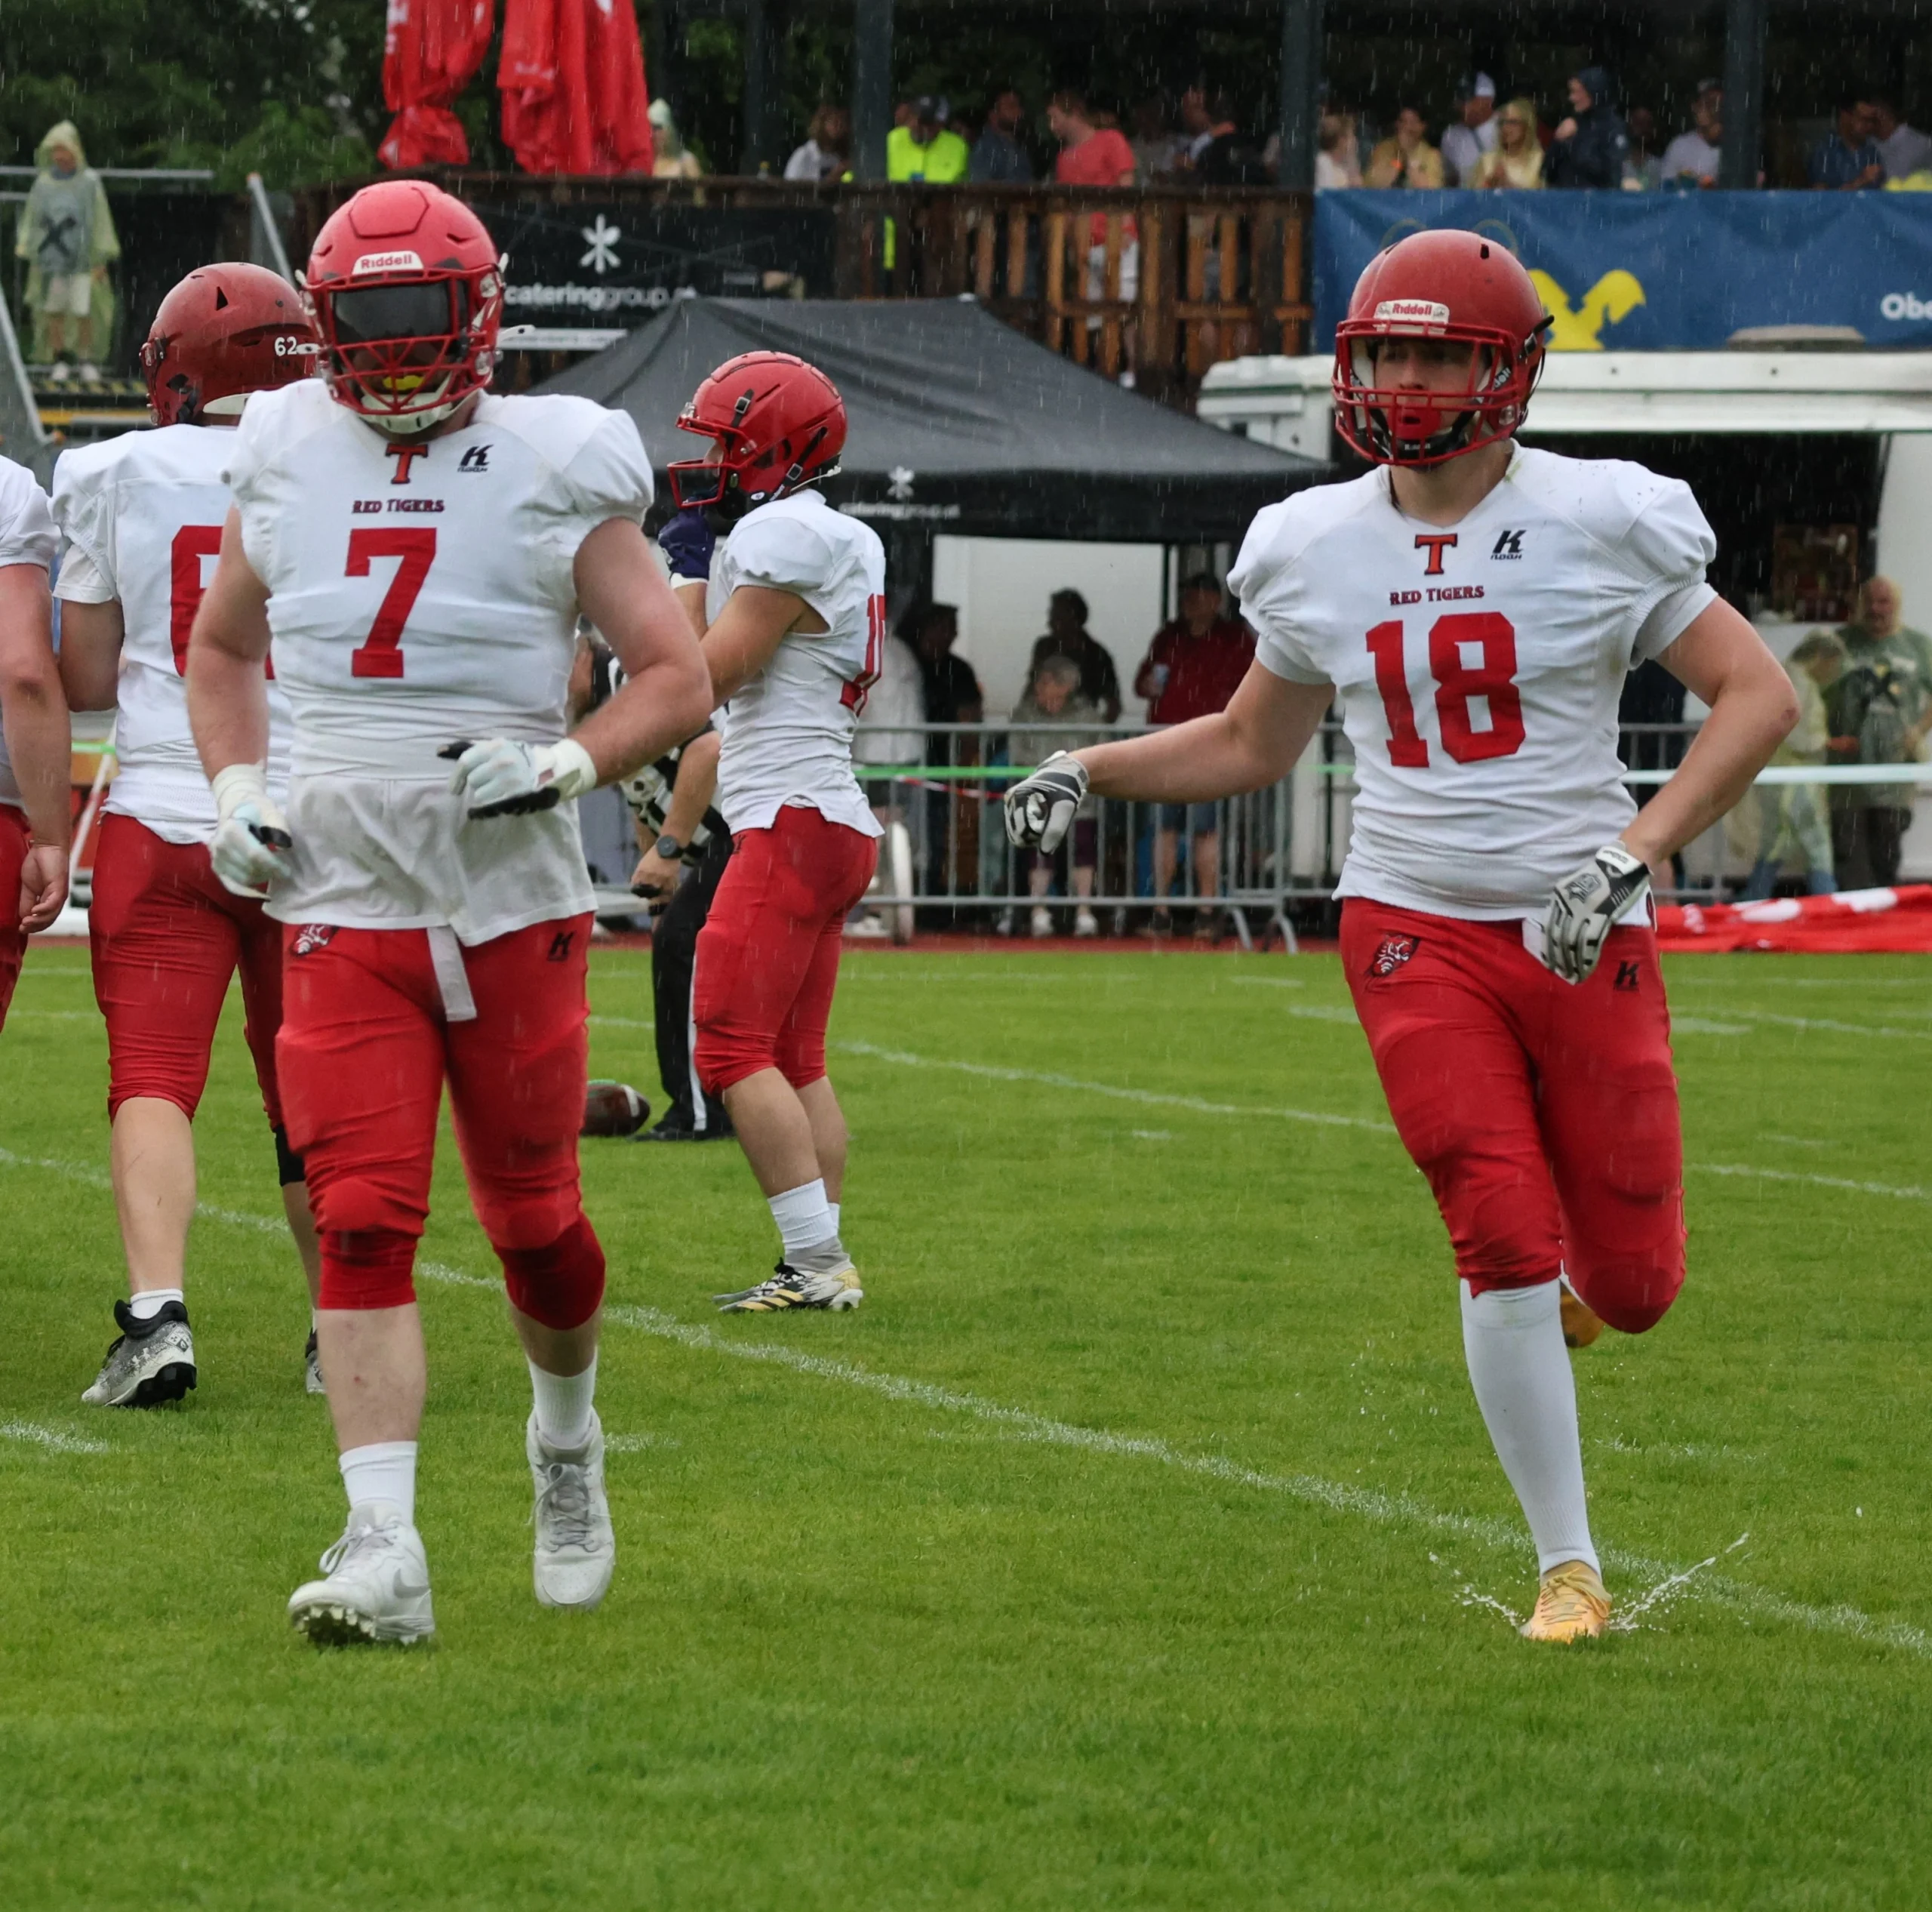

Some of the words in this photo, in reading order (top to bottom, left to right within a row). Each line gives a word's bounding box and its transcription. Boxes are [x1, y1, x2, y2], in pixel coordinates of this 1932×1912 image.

[361, 254, 413, 269] Riddell
[1392, 303, 1433, 316] Riddell
[274, 336, 297, 357] 62
[385, 442, 429, 485] T
[352, 499, 383, 514] RED
[386, 498, 445, 513] TIGERS
[1414, 533, 1458, 576] T
[344, 527, 437, 678] 7
[1389, 590, 1423, 606] RED
[1426, 585, 1485, 602] TIGERS
[1365, 611, 1526, 768] 18
